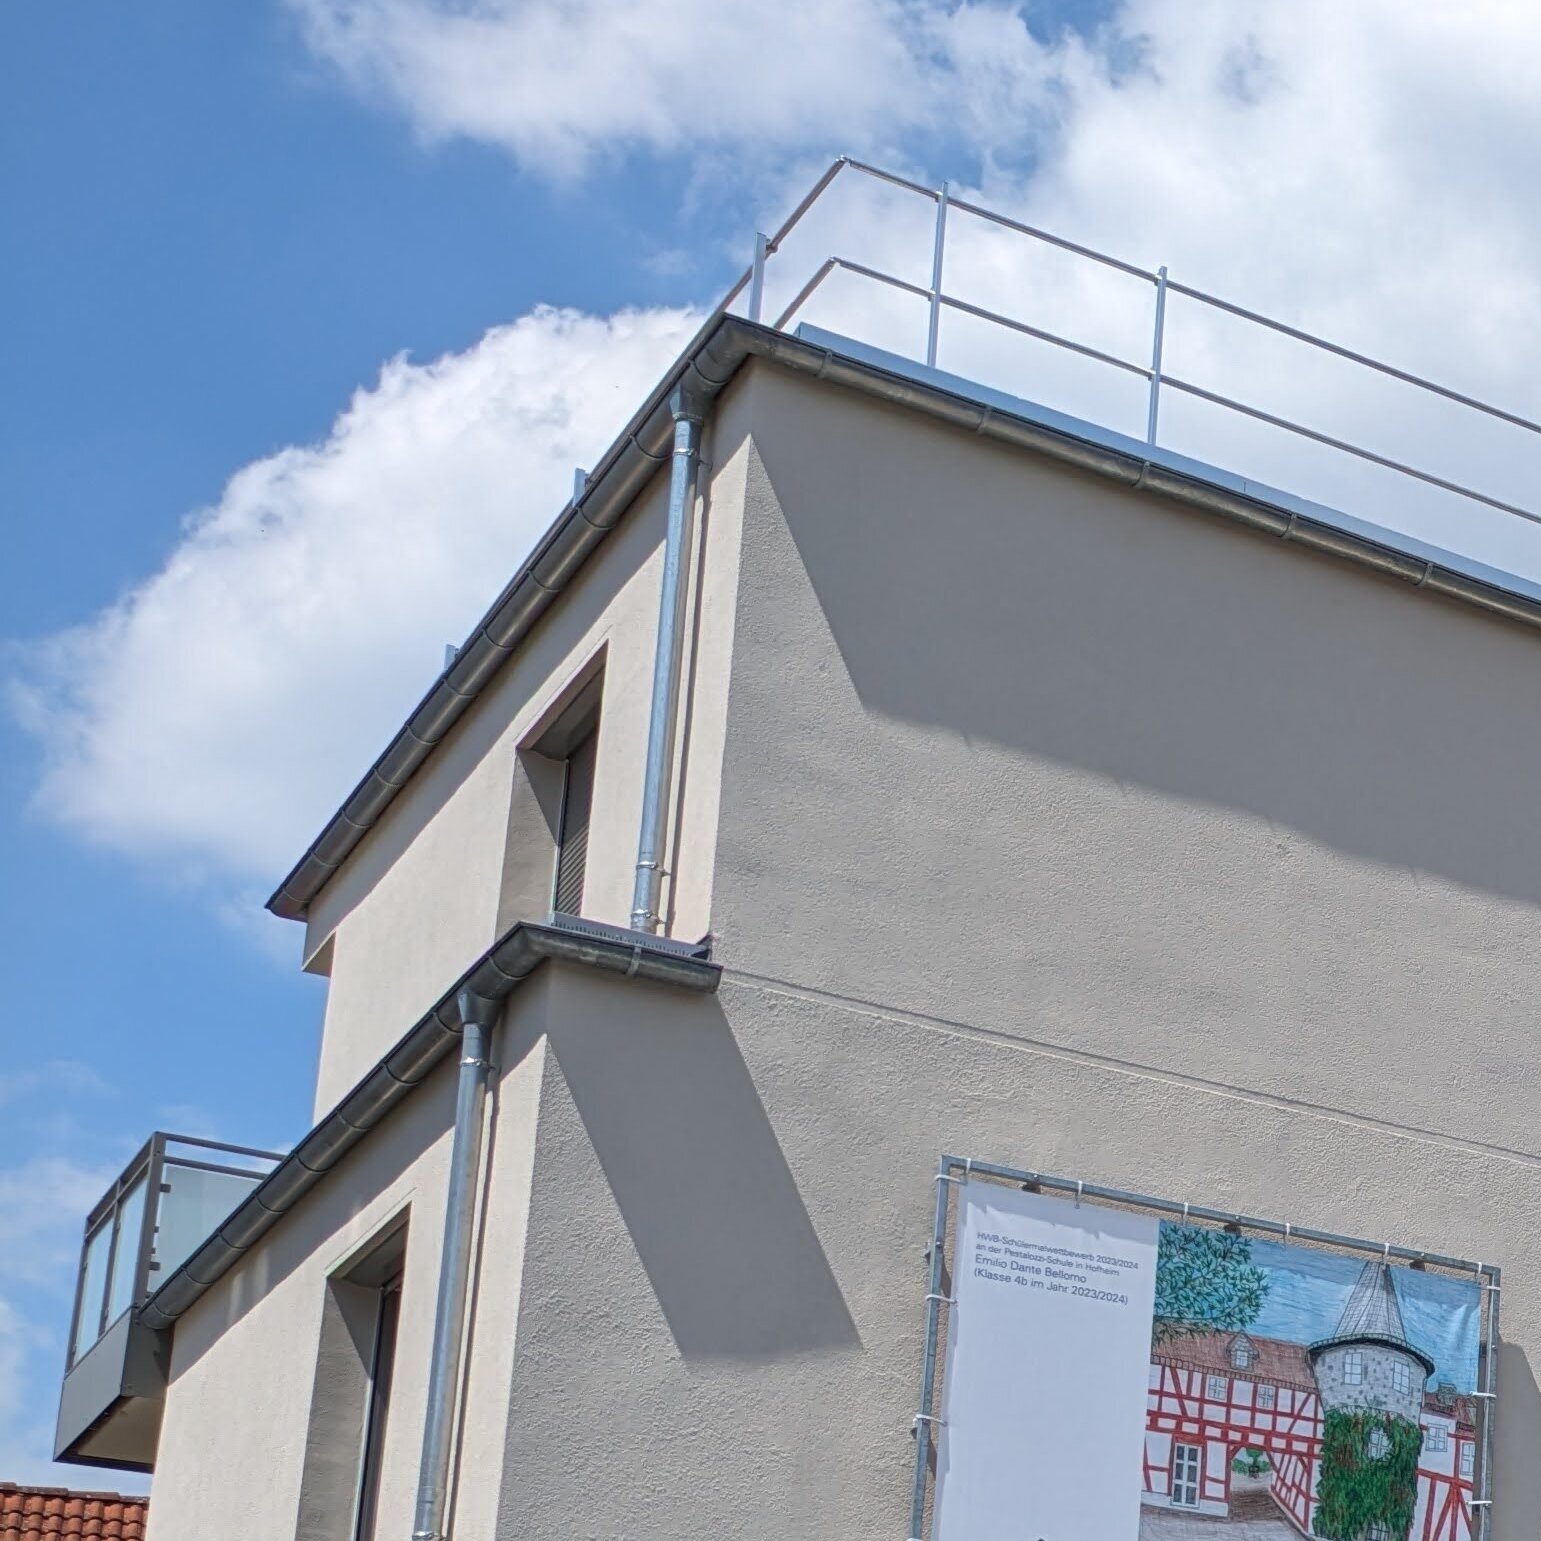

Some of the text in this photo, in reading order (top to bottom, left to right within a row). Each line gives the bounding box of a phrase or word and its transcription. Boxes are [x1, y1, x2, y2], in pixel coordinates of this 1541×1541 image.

[975, 1254, 1008, 1269] Emilio
[1010, 1261, 1042, 1275] Dante
[976, 1243, 986, 1251] an
[988, 1245, 1001, 1254] der
[1004, 1248, 1074, 1268] Pestalozzi-Schule
[1085, 1264, 1120, 1277] Hofheim
[1096, 1255, 1139, 1270] 2023/2024
[974, 1268, 1128, 1306] (Klasse 4b im Jahr 2023/2024)
